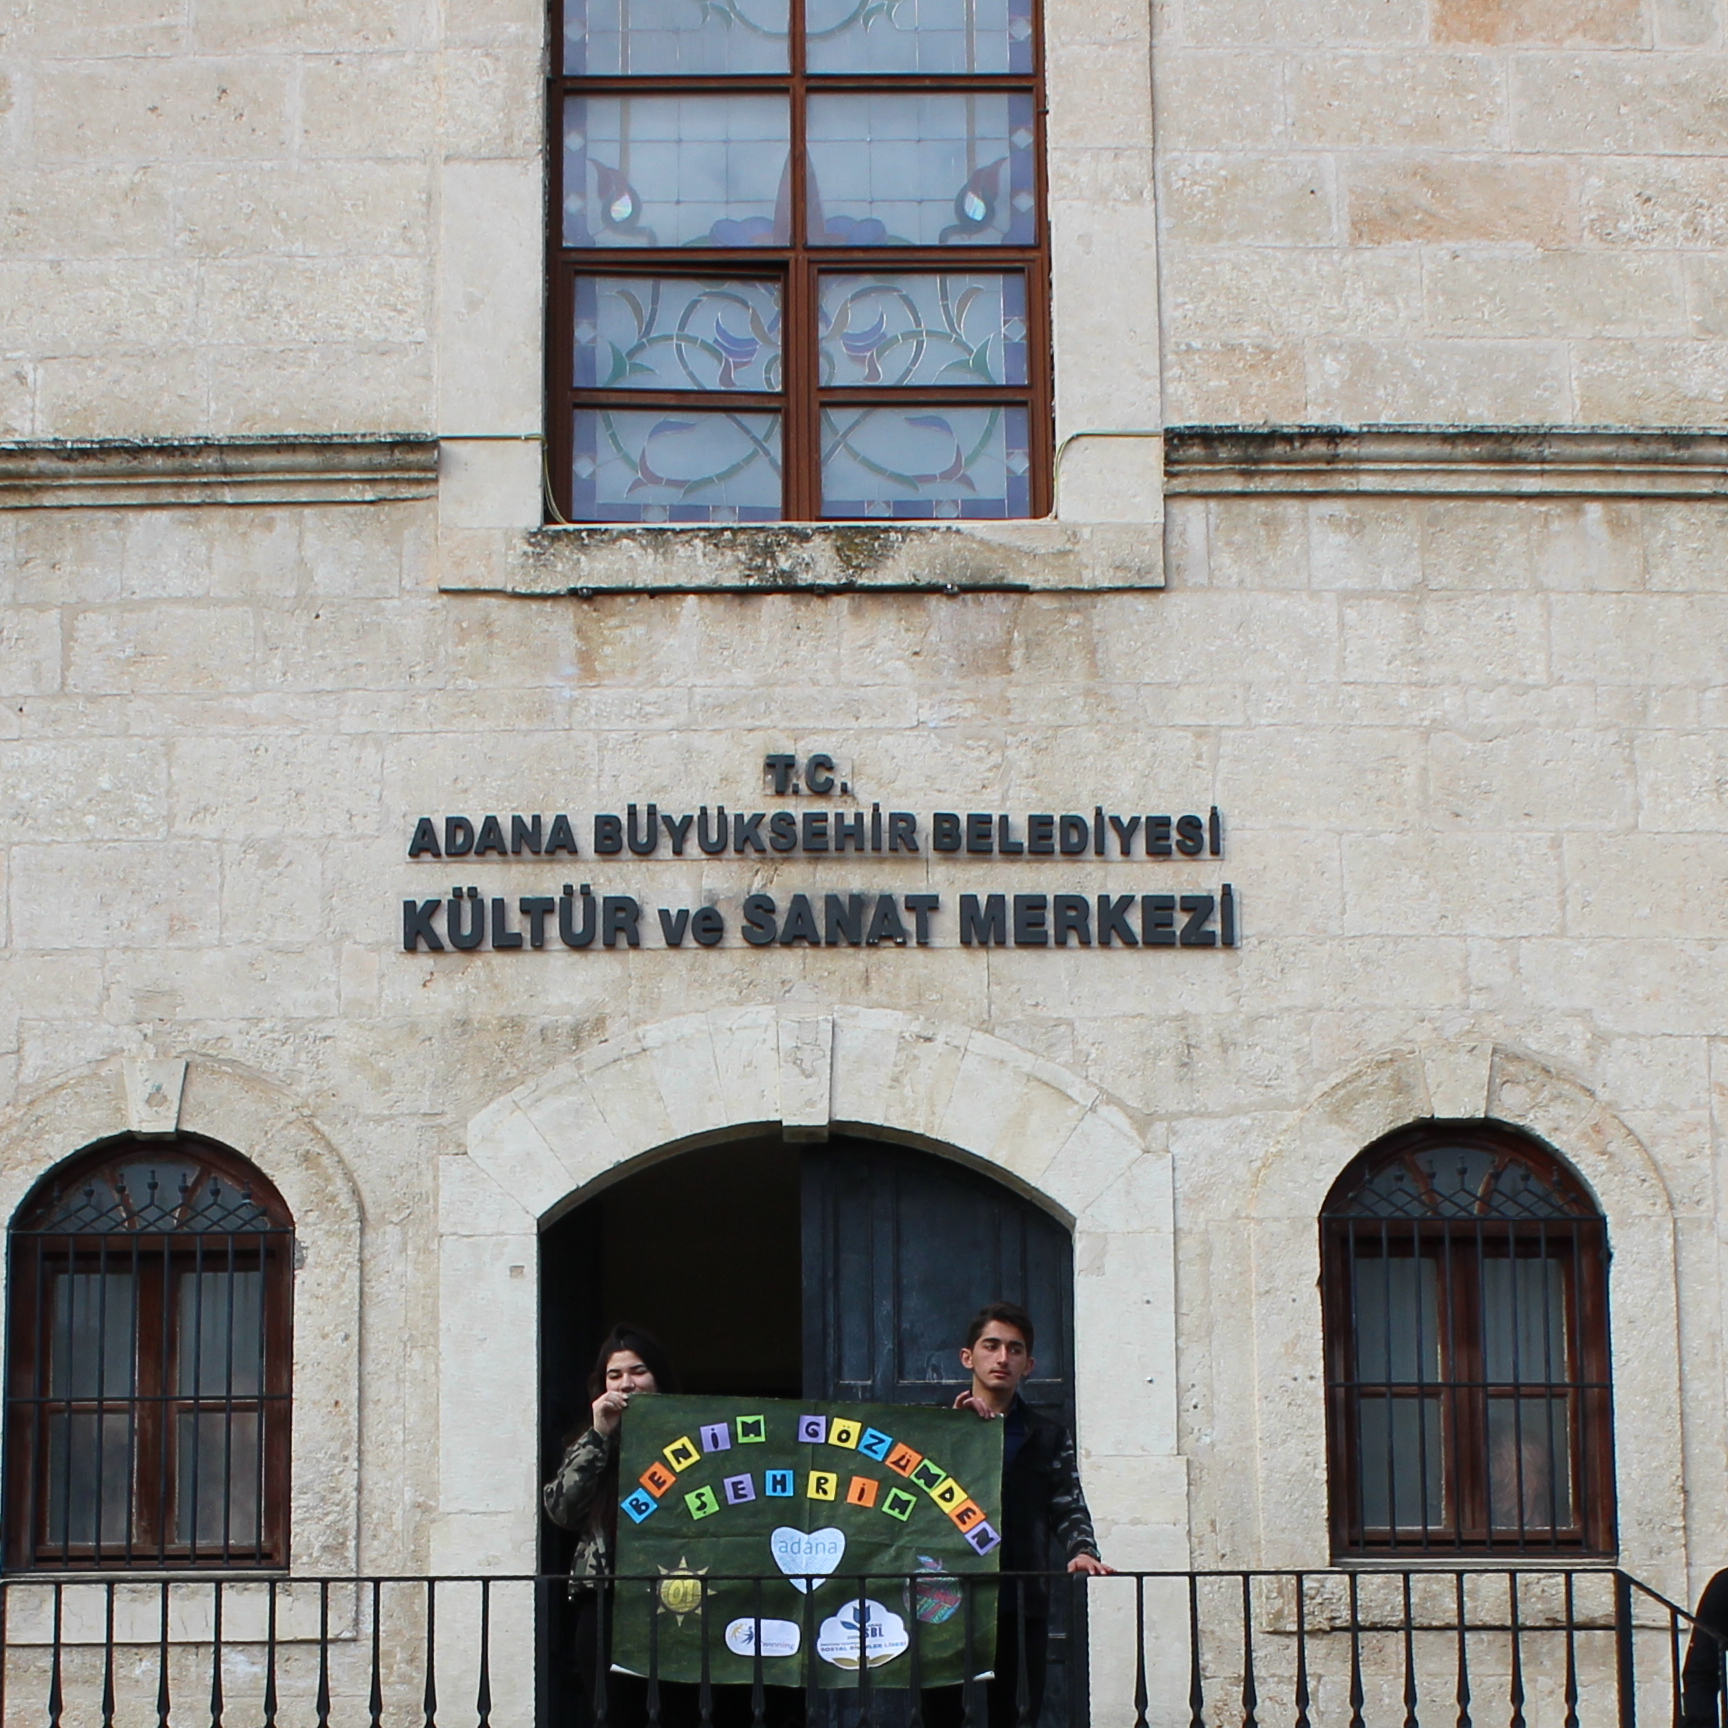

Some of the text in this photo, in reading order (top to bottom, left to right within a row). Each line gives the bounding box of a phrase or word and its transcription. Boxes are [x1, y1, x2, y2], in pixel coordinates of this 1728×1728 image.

[765, 754, 849, 795] T.C.
[408, 814, 579, 857] ADANA
[932, 806, 1221, 856] BELEDİYESİ
[403, 883, 1236, 951] KÜLTÜR ve SANAT MERKEZİ
[628, 1418, 996, 1550] BENİM GÖZÜMDEN
[778, 1538, 838, 1555] adana
